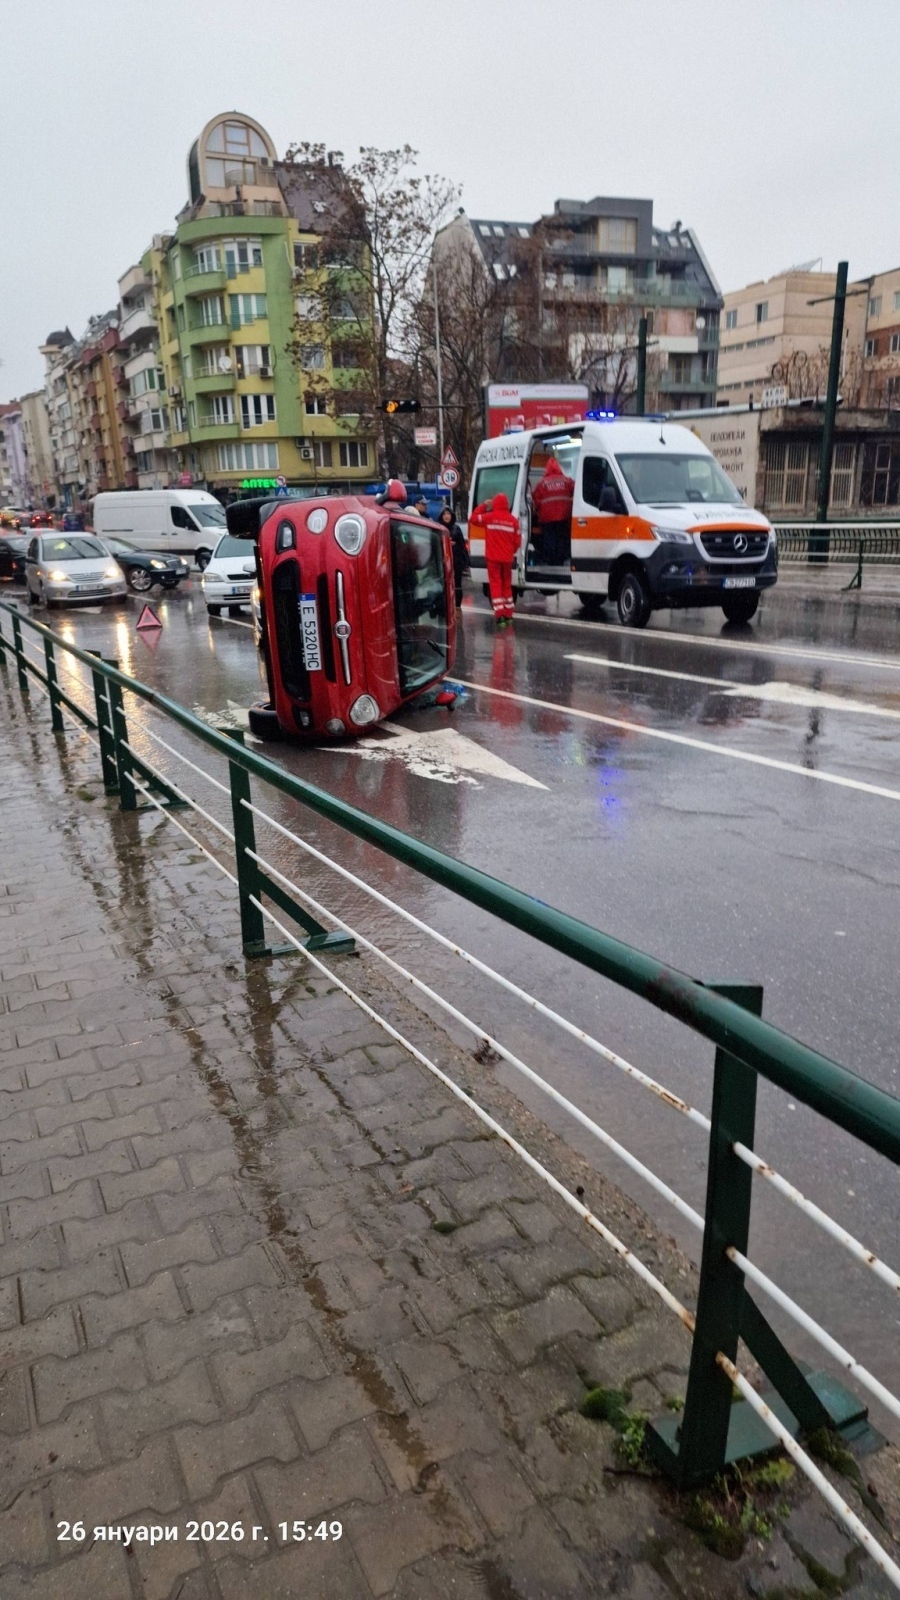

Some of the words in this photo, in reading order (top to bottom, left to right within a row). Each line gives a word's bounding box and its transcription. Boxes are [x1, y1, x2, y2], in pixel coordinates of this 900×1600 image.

[721, 462, 744, 473] ЕМОНТ
[242, 478, 278, 489] АПТЕК
[303, 606, 315, 615] E
[304, 620, 318, 650] 5320
